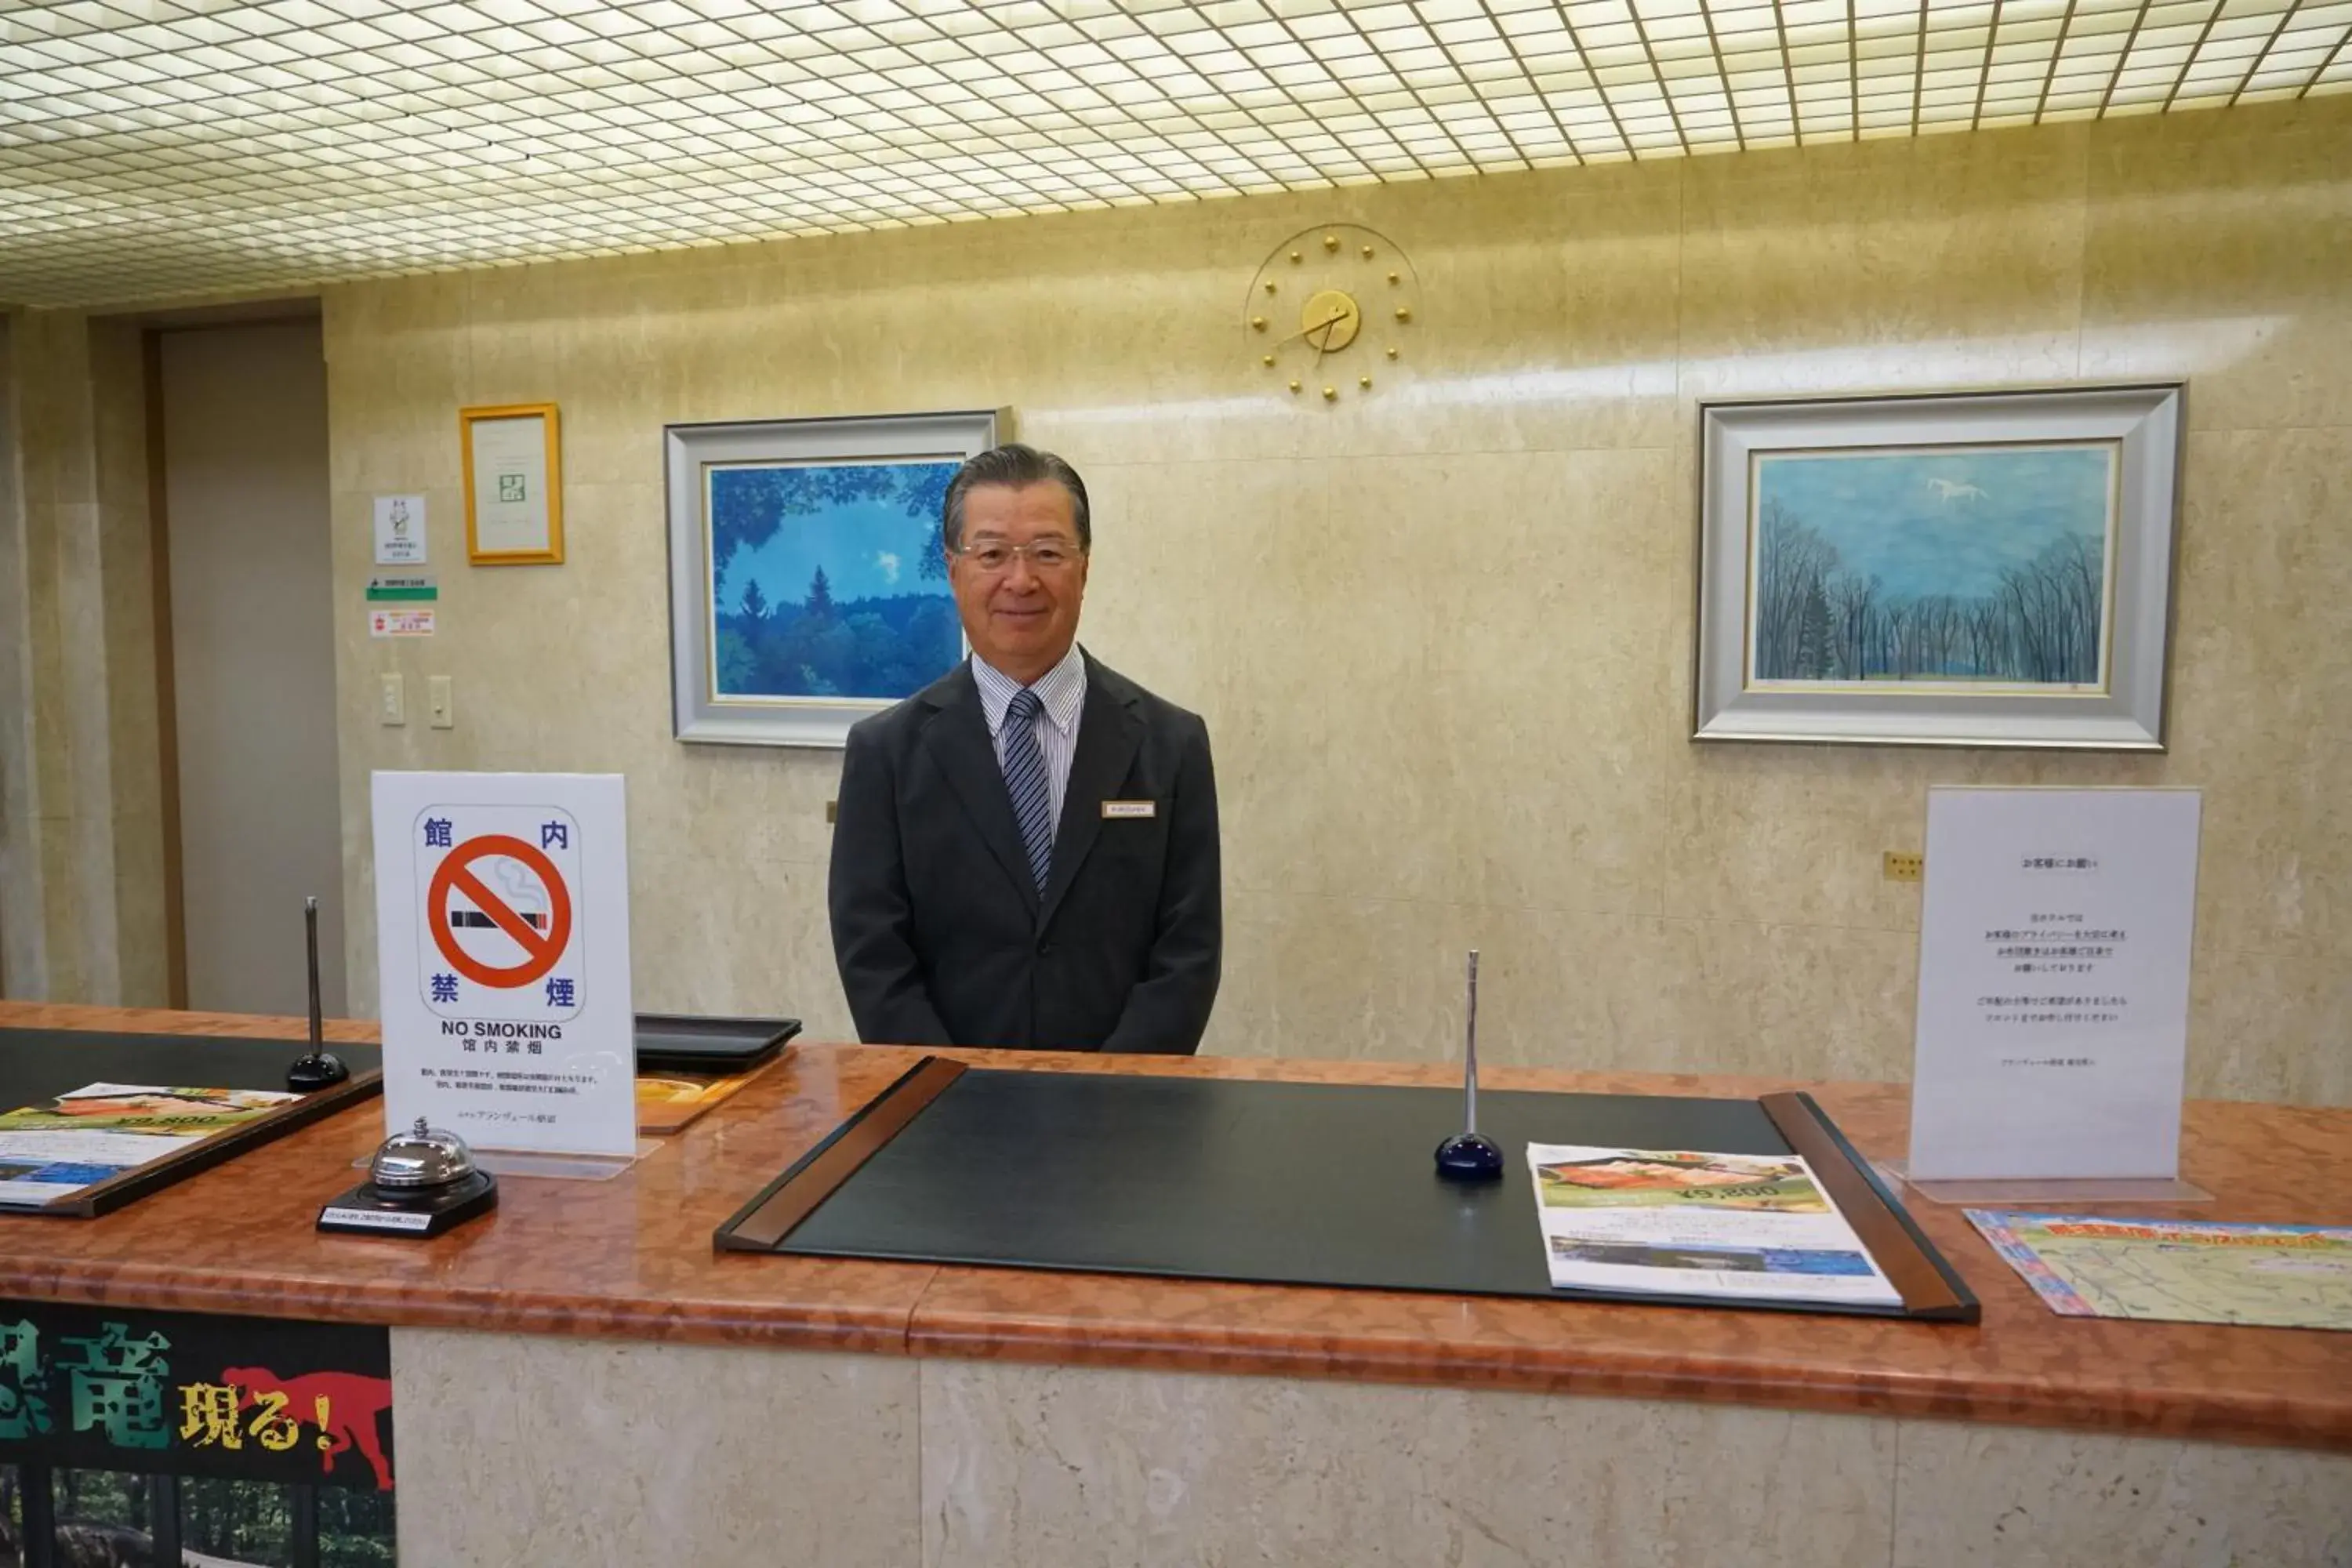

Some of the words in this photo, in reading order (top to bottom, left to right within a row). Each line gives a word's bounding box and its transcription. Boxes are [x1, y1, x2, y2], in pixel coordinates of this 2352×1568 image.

[424, 818, 452, 848] 館
[541, 820, 568, 849] 内
[431, 973, 459, 1003] 禁
[546, 977, 575, 1007] 煙
[441, 1021, 469, 1036] NO
[474, 1022, 562, 1039] SMOKING
